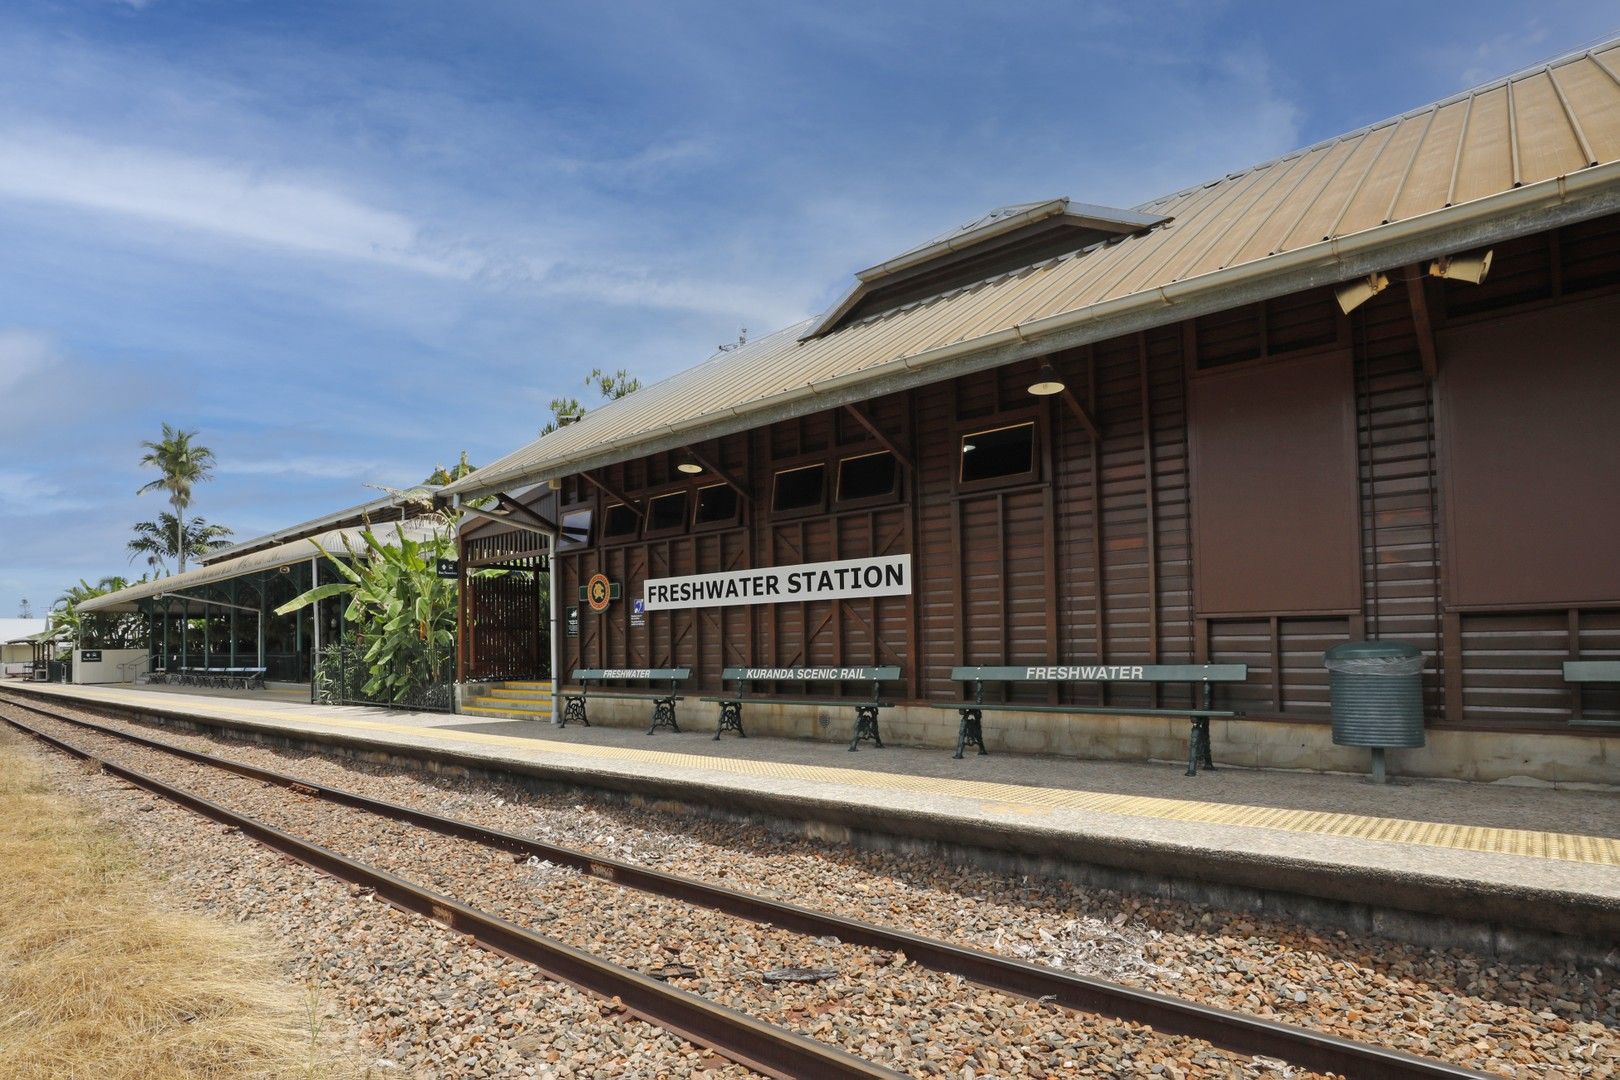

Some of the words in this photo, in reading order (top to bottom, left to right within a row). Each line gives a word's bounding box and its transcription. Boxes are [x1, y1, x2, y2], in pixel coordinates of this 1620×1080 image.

[648, 576, 780, 603] FRESHWATER
[787, 563, 904, 594] STATION
[602, 669, 651, 679] FRESHWATER
[746, 669, 794, 680] KURANDA
[797, 669, 838, 680] SCENIC
[840, 669, 866, 680] RAIL
[1027, 666, 1143, 680] FRESHWATER
